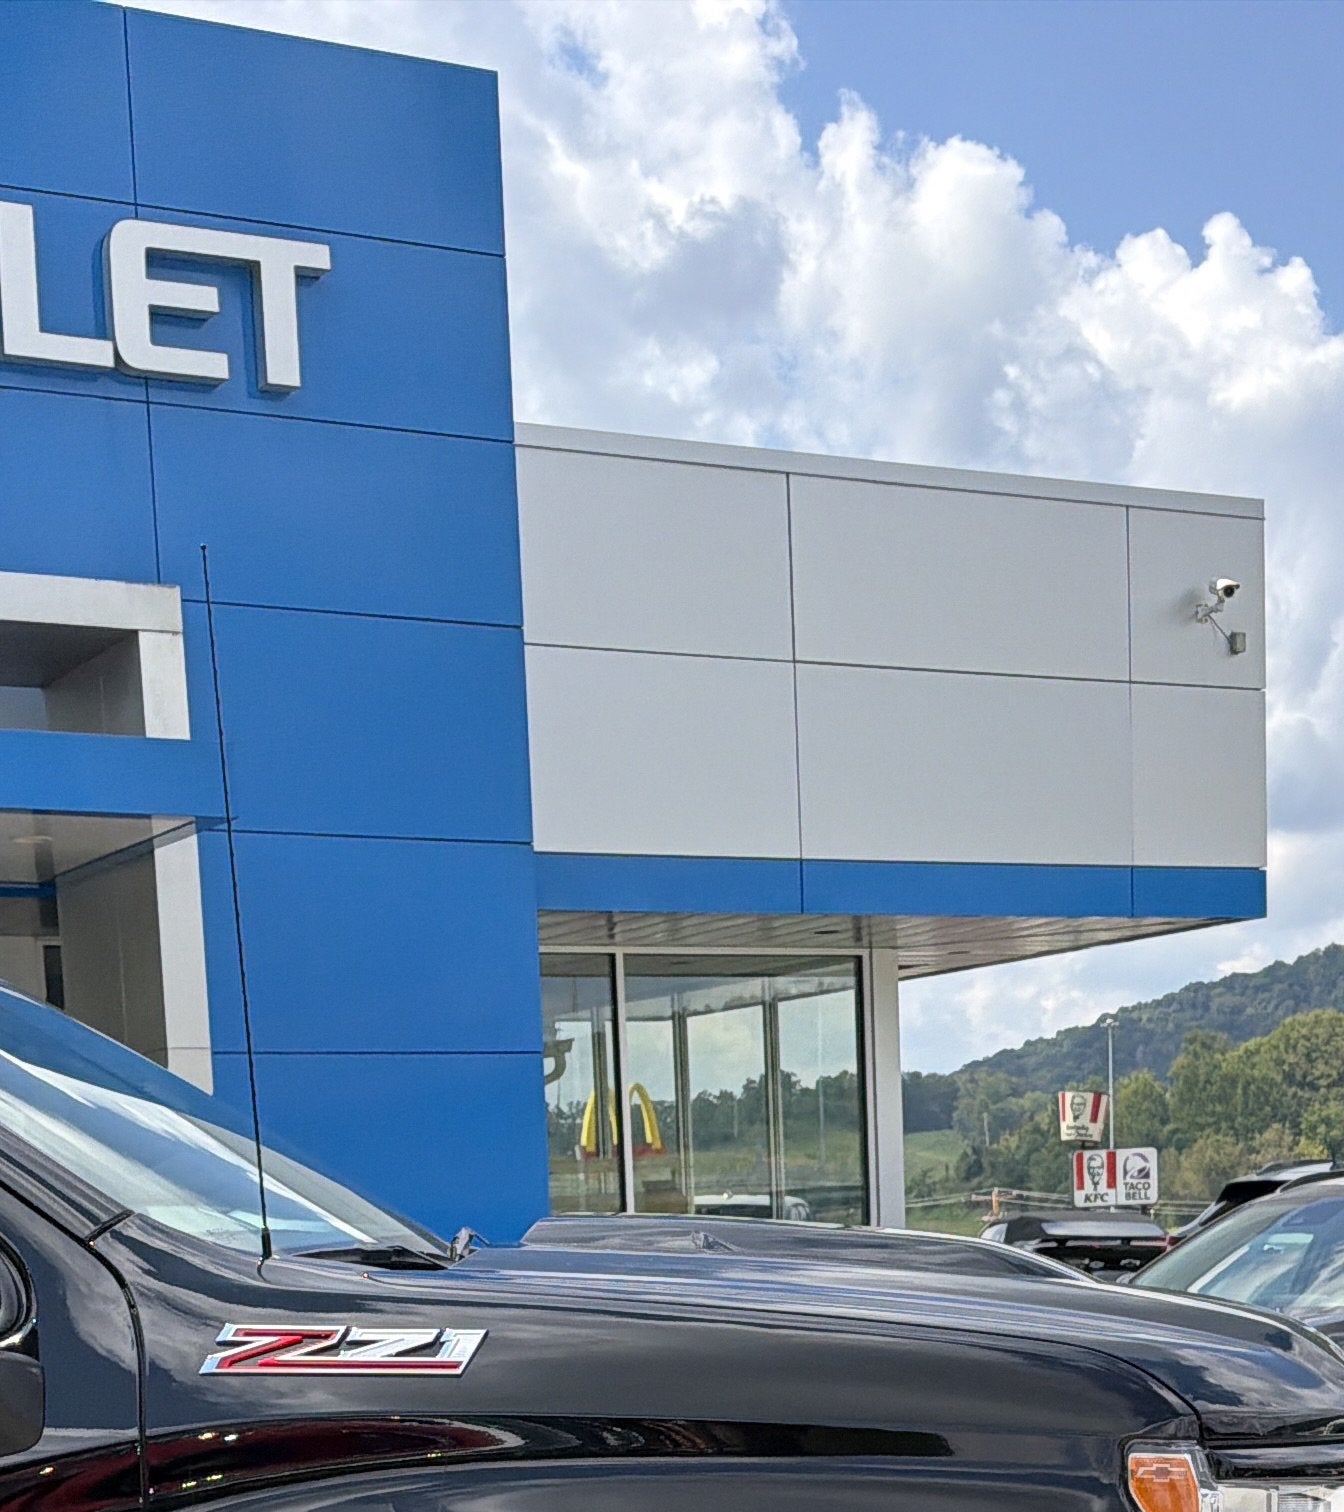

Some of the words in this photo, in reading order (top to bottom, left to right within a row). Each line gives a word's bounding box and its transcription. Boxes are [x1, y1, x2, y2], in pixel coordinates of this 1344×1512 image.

[1123, 1182, 1152, 1191] TACO
[1083, 1191, 1109, 1204] KFC
[1124, 1191, 1151, 1201] BELL
[199, 1323, 490, 1377] Z71
